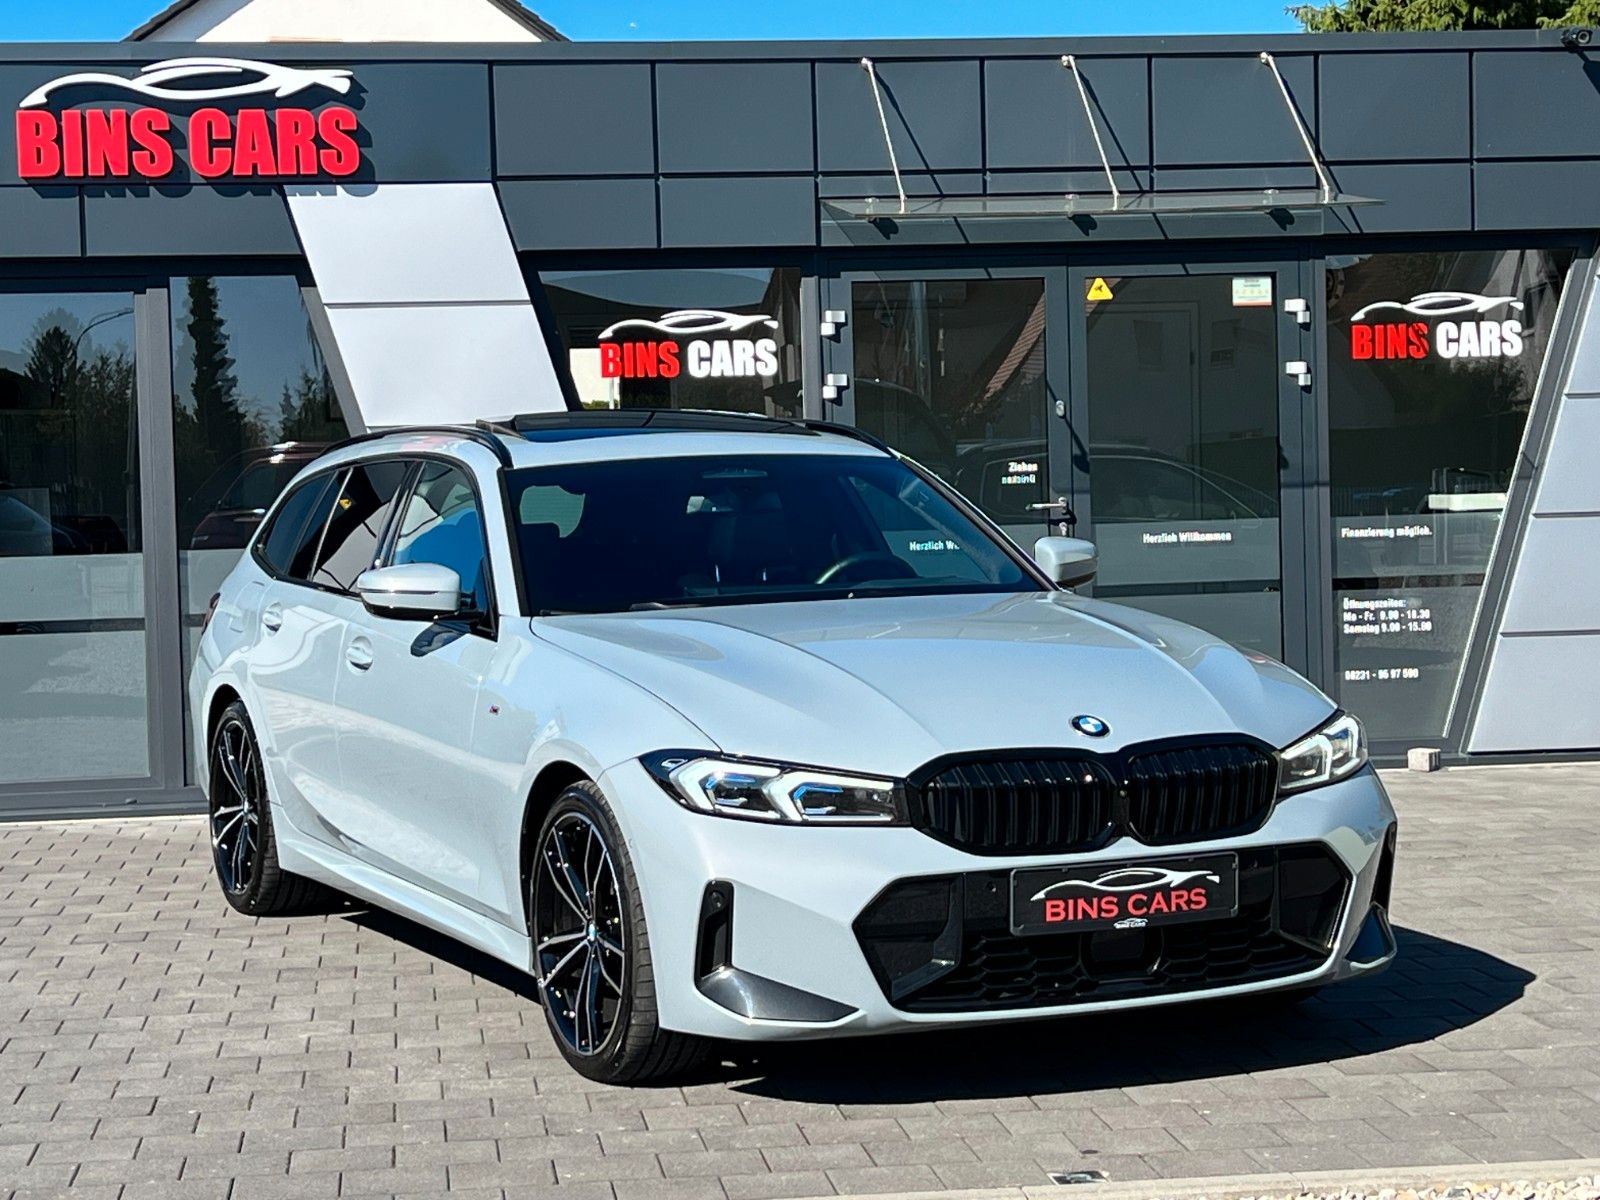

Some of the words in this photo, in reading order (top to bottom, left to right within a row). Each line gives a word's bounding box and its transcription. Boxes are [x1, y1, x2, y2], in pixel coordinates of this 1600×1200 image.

[16, 108, 173, 178] BINS
[188, 107, 360, 177] CARS
[1351, 322, 1430, 360] BINS
[1435, 319, 1523, 359] CARS
[600, 341, 680, 379] BINS
[687, 338, 778, 378] CARS
[1143, 533, 1178, 544] Herzlich
[1178, 531, 1232, 542] Willkommen
[1341, 527, 1395, 538] Finanzierung
[1396, 525, 1433, 538] möglich.
[909, 541, 944, 551] Herzlich
[1343, 611, 1357, 622] Mo
[1343, 622, 1380, 634] Samstag
[1045, 898, 1119, 922] BINS
[1127, 887, 1207, 917] CARS
